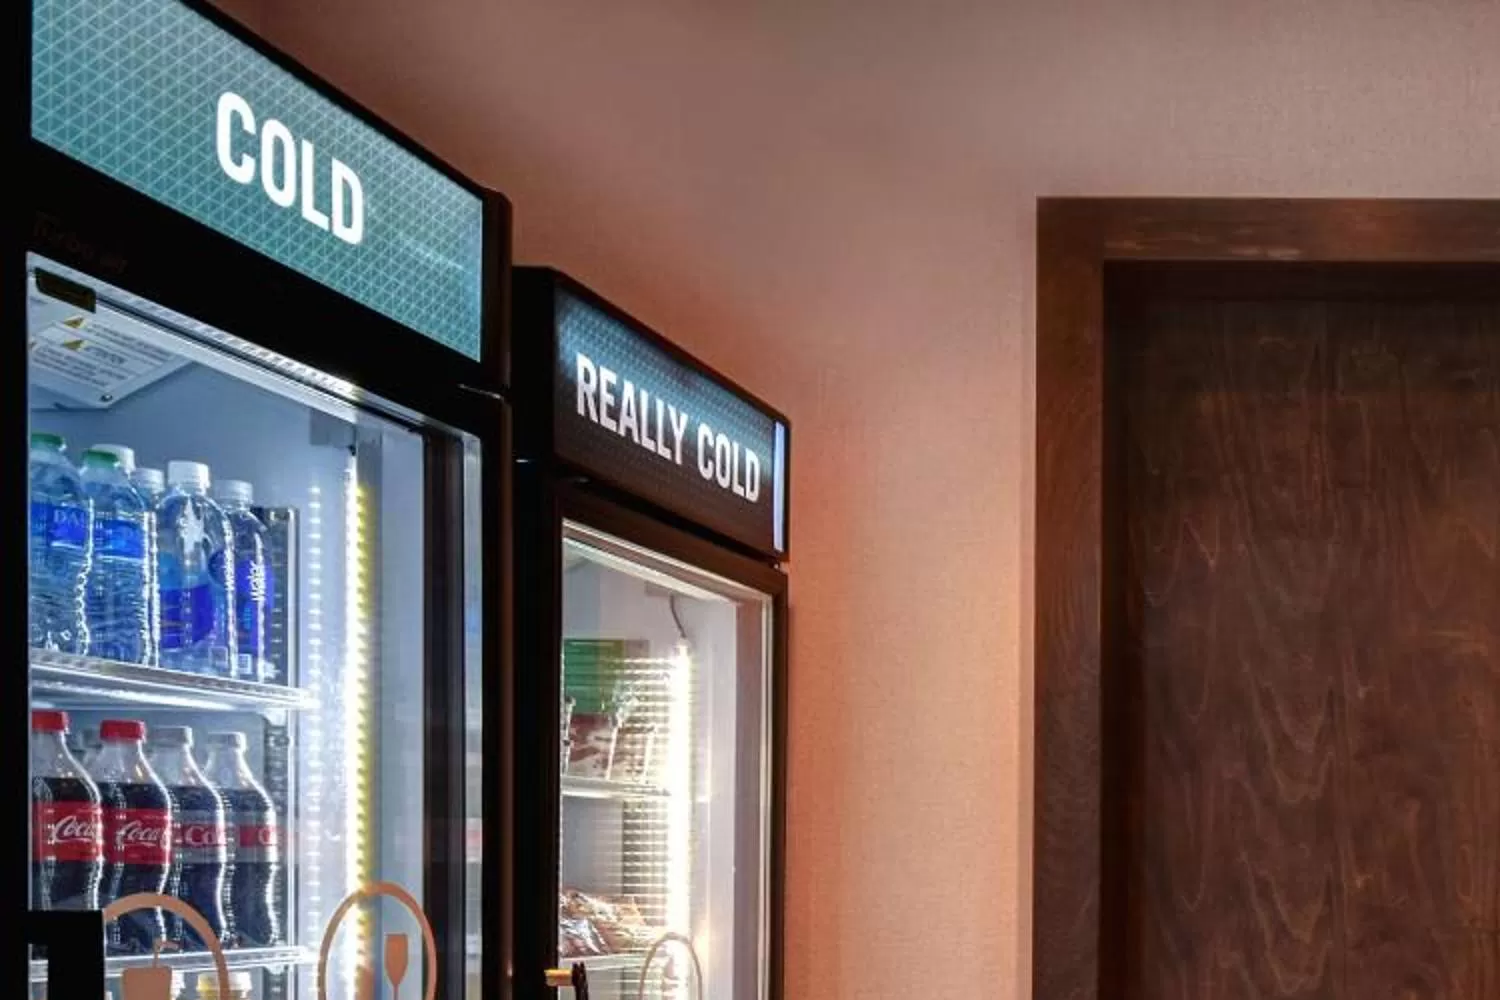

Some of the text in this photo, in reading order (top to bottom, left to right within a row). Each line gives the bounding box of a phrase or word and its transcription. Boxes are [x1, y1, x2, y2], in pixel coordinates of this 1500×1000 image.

[215, 90, 366, 247] COLD
[575, 351, 762, 504] REALLY COLD
